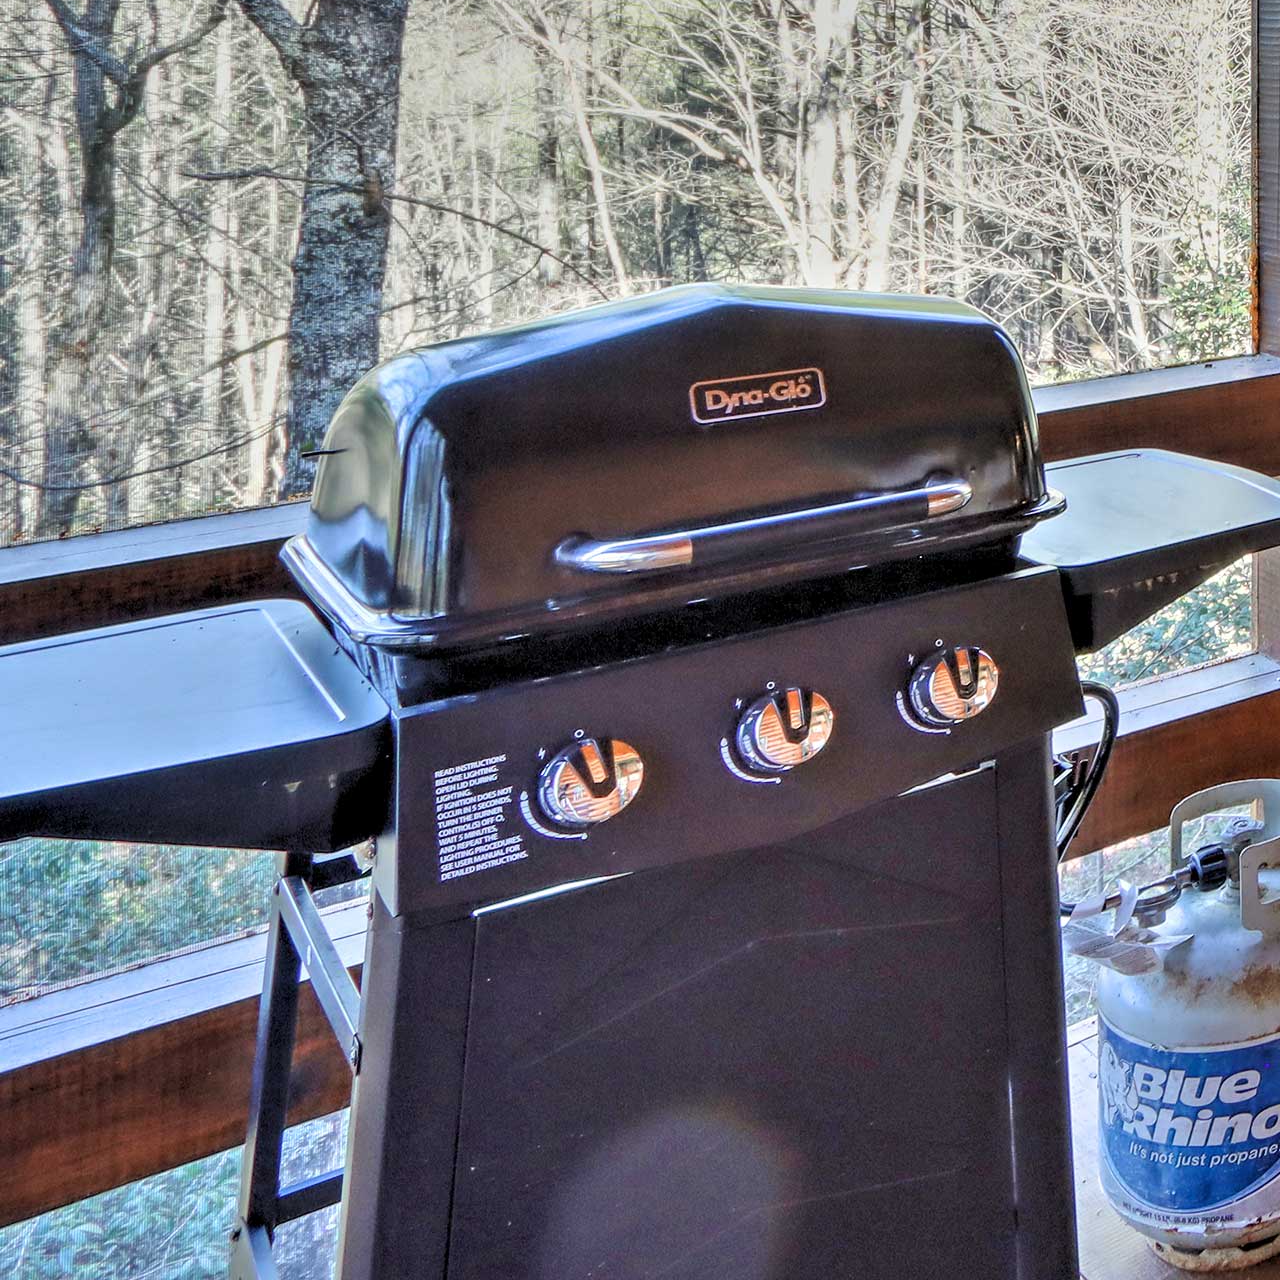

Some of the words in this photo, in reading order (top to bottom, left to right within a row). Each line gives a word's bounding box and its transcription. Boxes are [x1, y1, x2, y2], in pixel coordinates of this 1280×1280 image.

[434, 768, 455, 778] READ
[455, 754, 507, 771] INSTRUCTIONS
[435, 774, 463, 787] BEFORE
[435, 785, 456, 795] OPEN
[456, 780, 469, 790] LID
[469, 773, 498, 787] DURING
[436, 789, 473, 804] LIGHTING.
[436, 804, 444, 812] IF
[444, 796, 476, 810] IGNITION
[477, 790, 497, 801] DOES
[497, 785, 513, 795] NOT
[437, 808, 463, 820] OCCUR
[463, 805, 472, 813] IN
[472, 804, 477, 812] 5
[437, 819, 458, 829] TURN
[458, 815, 473, 824] THE
[473, 806, 503, 818] BURNER
[438, 821, 480, 837] CONTROL(S)
[481, 817, 495, 826] OFF
[439, 836, 457, 847] WAIT
[458, 834, 463, 842] 5
[439, 845, 456, 855] AND
[456, 838, 485, 851] REPEAT
[485, 833, 499, 842] THE
[440, 848, 474, 864] LIGHTING
[440, 862, 454, 872] SEE
[454, 857, 473, 868] USER
[474, 848, 505, 864] MANUAL
[505, 844, 521, 854] FOR
[441, 865, 475, 881] DETAILED
[475, 850, 529, 872] INSTRUCTIONS.
[1132, 1063, 1261, 1107] Blue
[1130, 1141, 1147, 1159] It's
[1150, 1150, 1173, 1165] not
[1175, 1154, 1206, 1169] just
[1201, 1214, 1234, 1225] PROPANE
